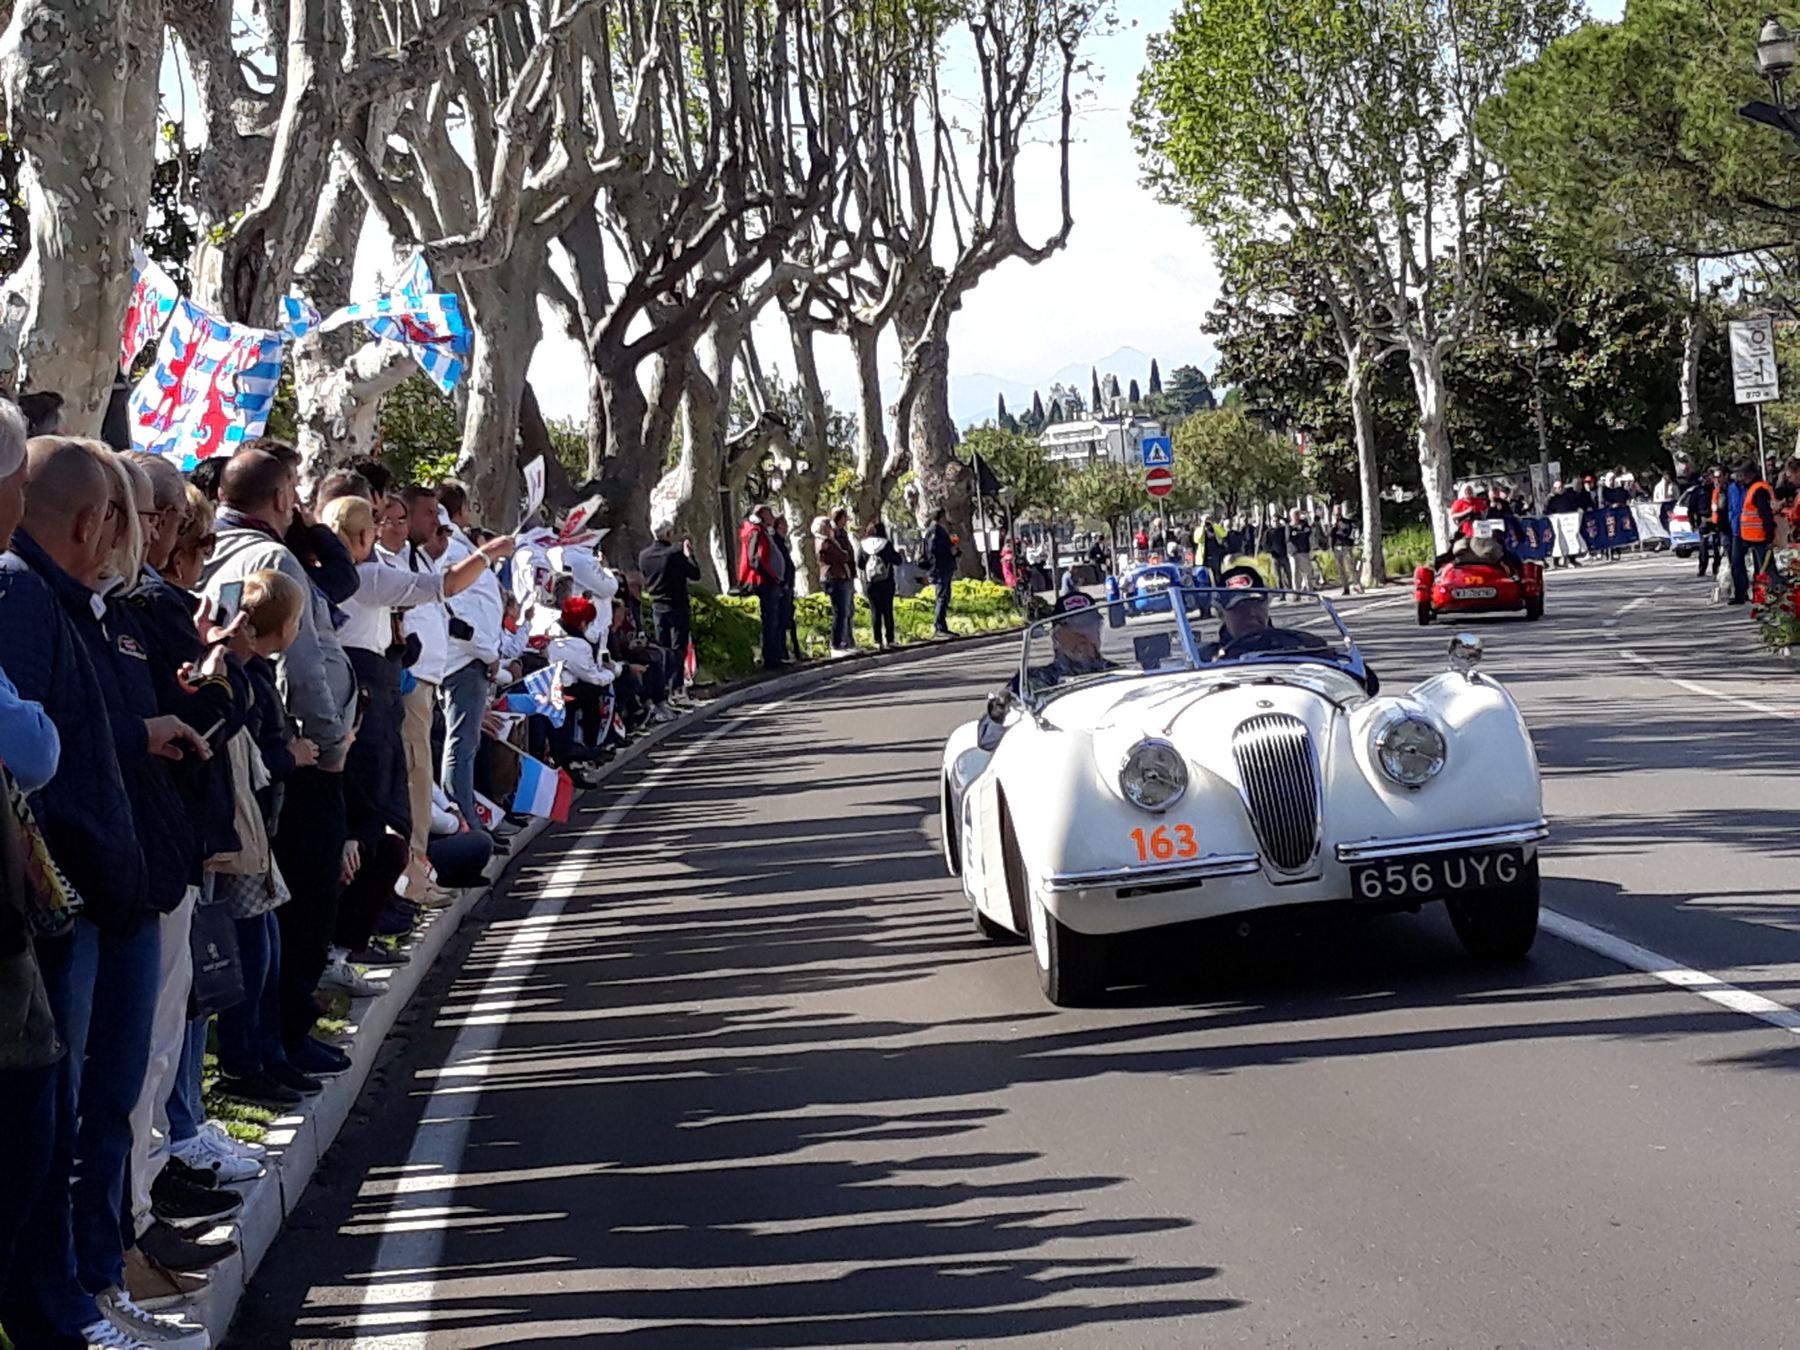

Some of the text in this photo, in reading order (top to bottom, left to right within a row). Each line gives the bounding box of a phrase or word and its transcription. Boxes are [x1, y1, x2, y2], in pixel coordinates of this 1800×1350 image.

[1129, 824, 1198, 862] 163
[1360, 853, 1518, 898] 656 UYG
